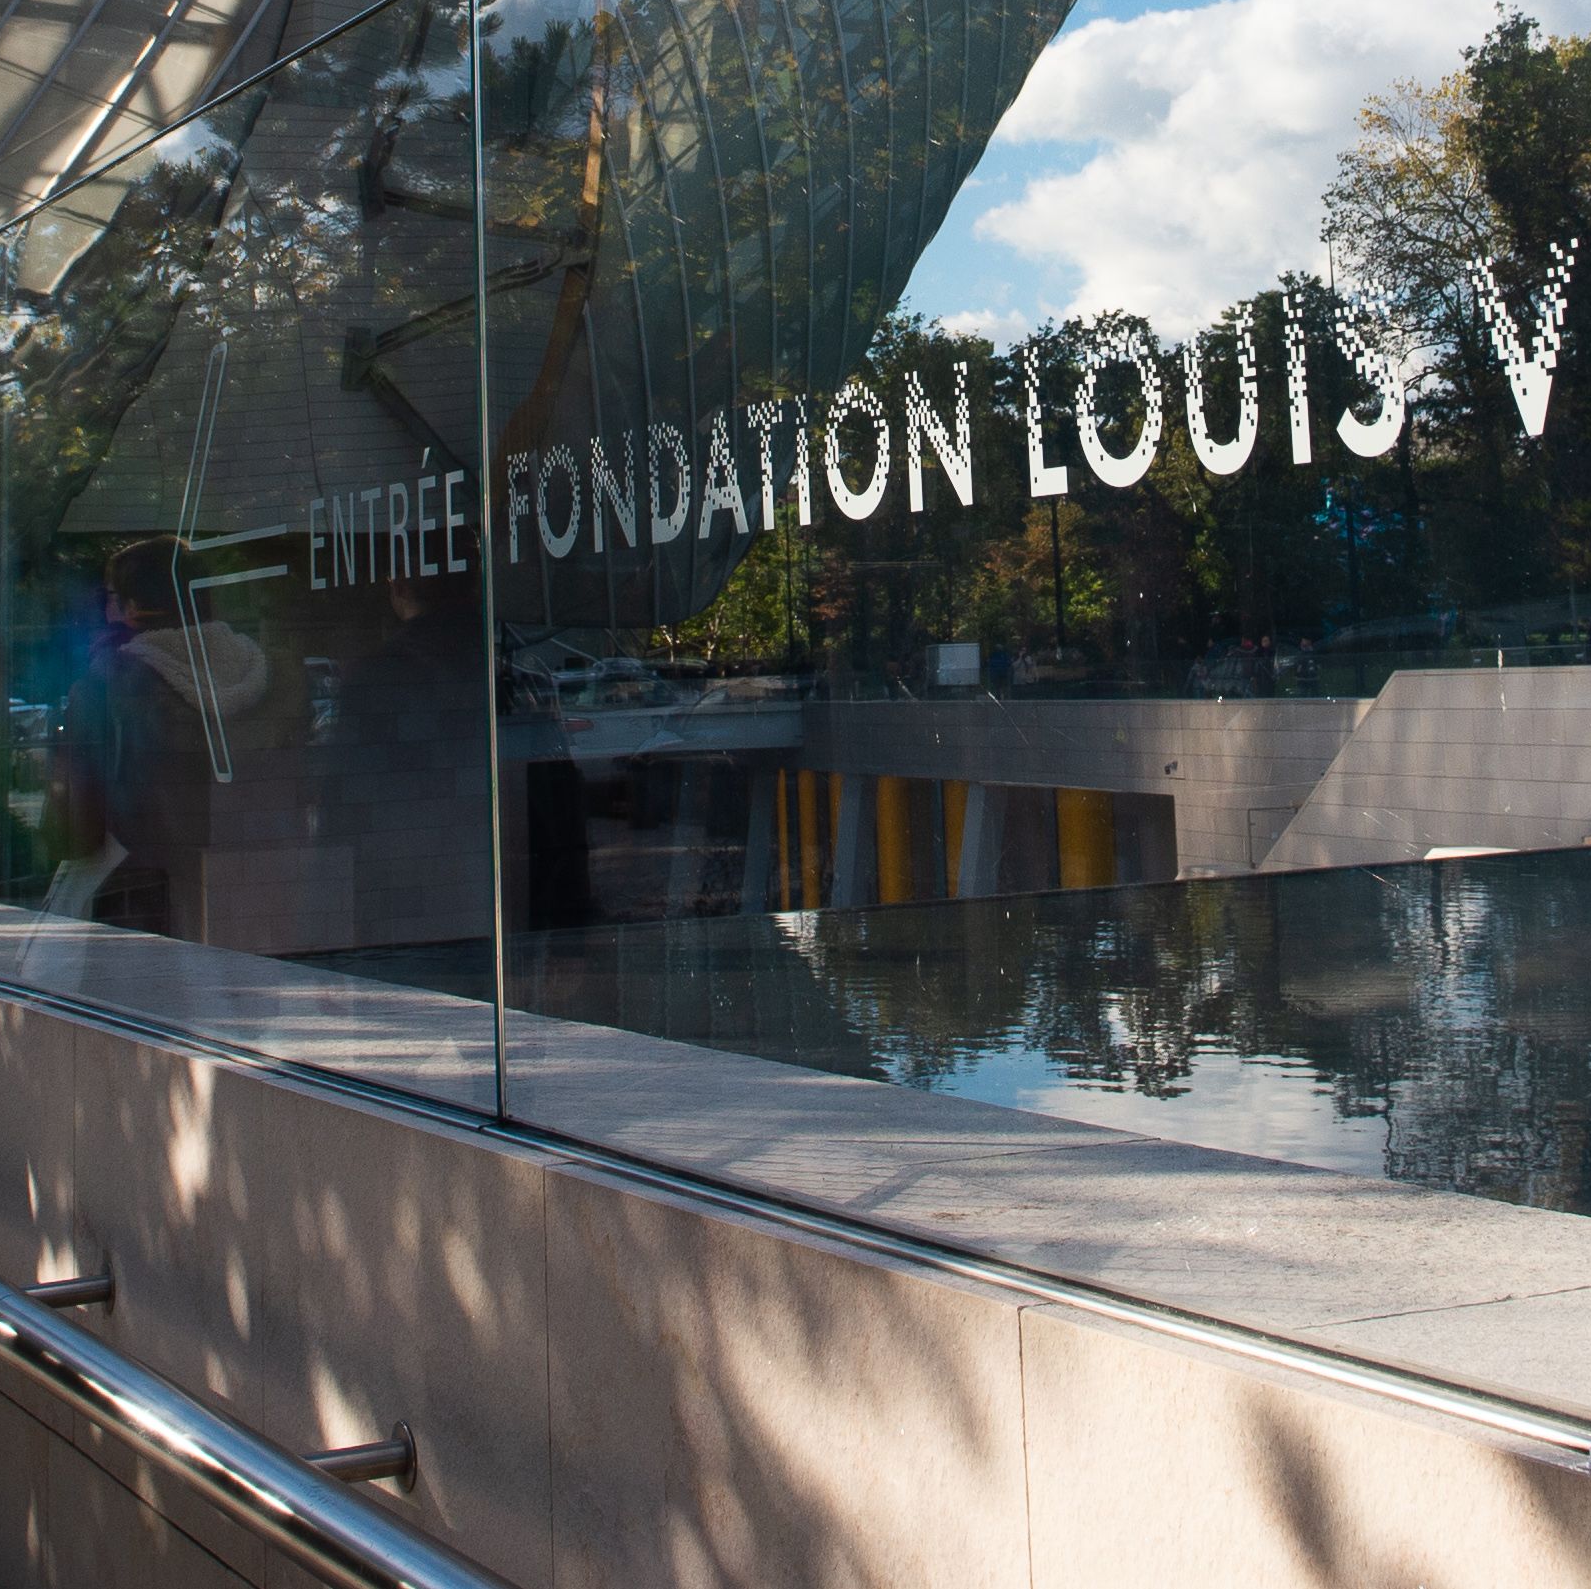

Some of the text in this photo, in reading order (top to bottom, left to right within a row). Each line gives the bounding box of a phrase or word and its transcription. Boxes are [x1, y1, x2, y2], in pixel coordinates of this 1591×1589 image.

[310, 447, 467, 590] ENTRÉE
[507, 362, 973, 563] FONDATION
[1024, 279, 1406, 497] LOUIS
